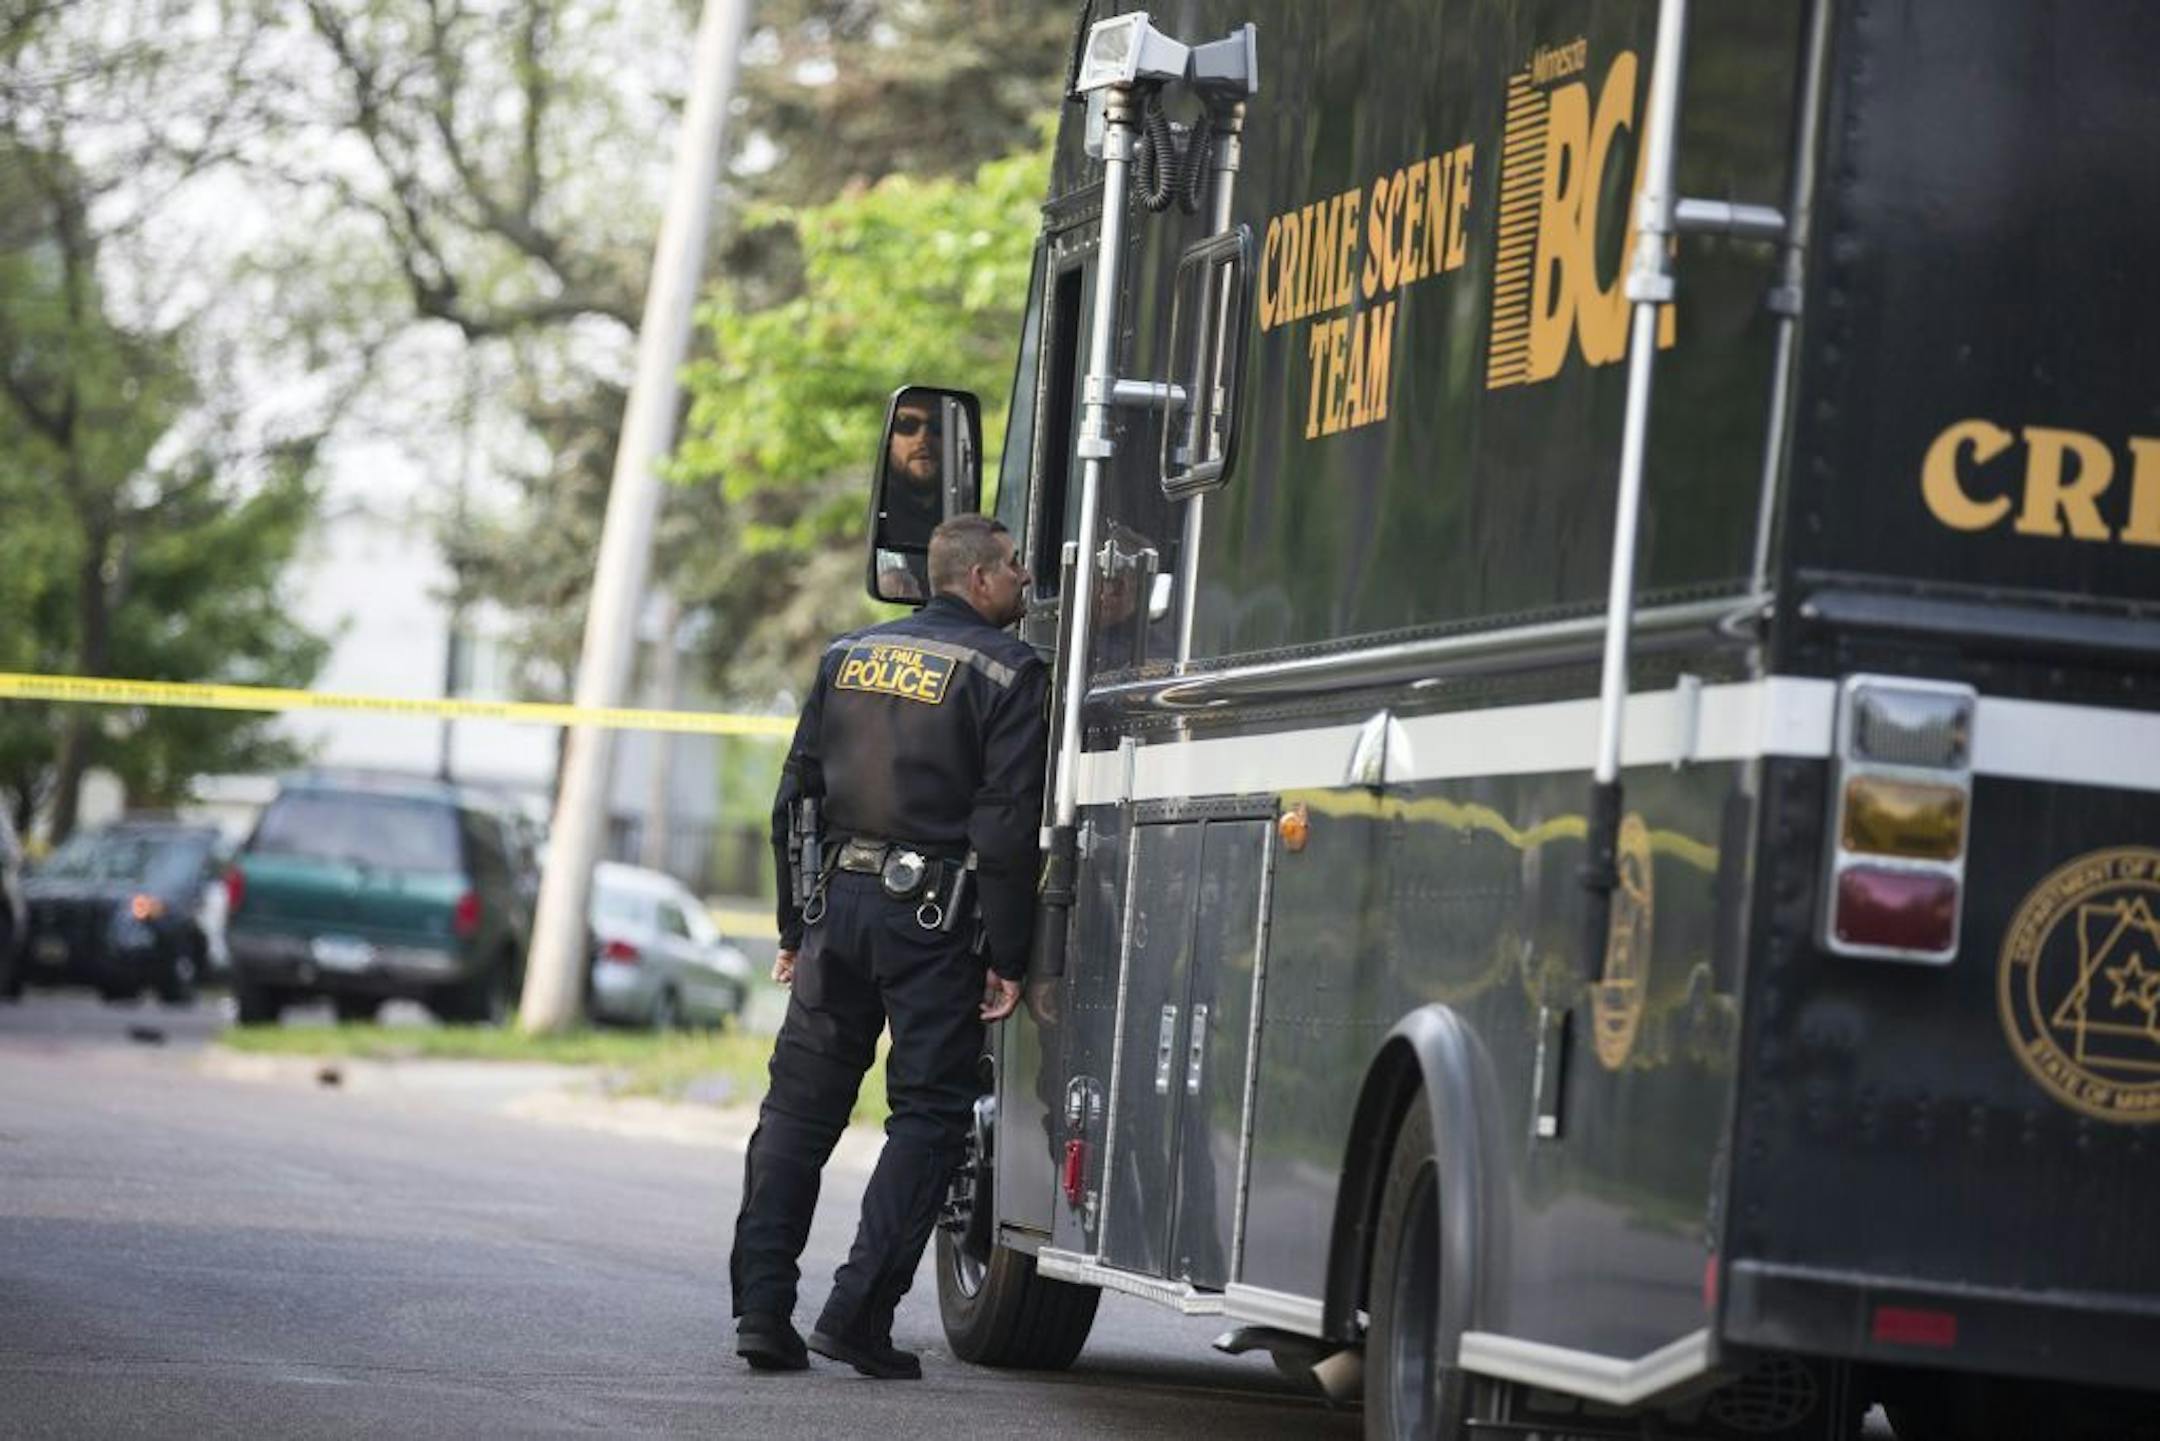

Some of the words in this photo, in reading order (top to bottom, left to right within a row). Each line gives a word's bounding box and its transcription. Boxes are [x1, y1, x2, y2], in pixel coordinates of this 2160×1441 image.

[1533, 36, 1587, 83] Minnesota
[1259, 187, 1361, 333] CRIME
[1362, 143, 1475, 299] SCENE
[1305, 300, 1396, 440] TEAM
[1921, 417, 2160, 548] CRI
[843, 659, 942, 698] POLICE
[889, 648, 925, 668] PAUL
[2011, 856, 2115, 964] DEPARTMENT
[2117, 857, 2150, 881] OF
[2028, 1038, 2081, 1102] STATE
[2081, 1080, 2114, 1107] OF
